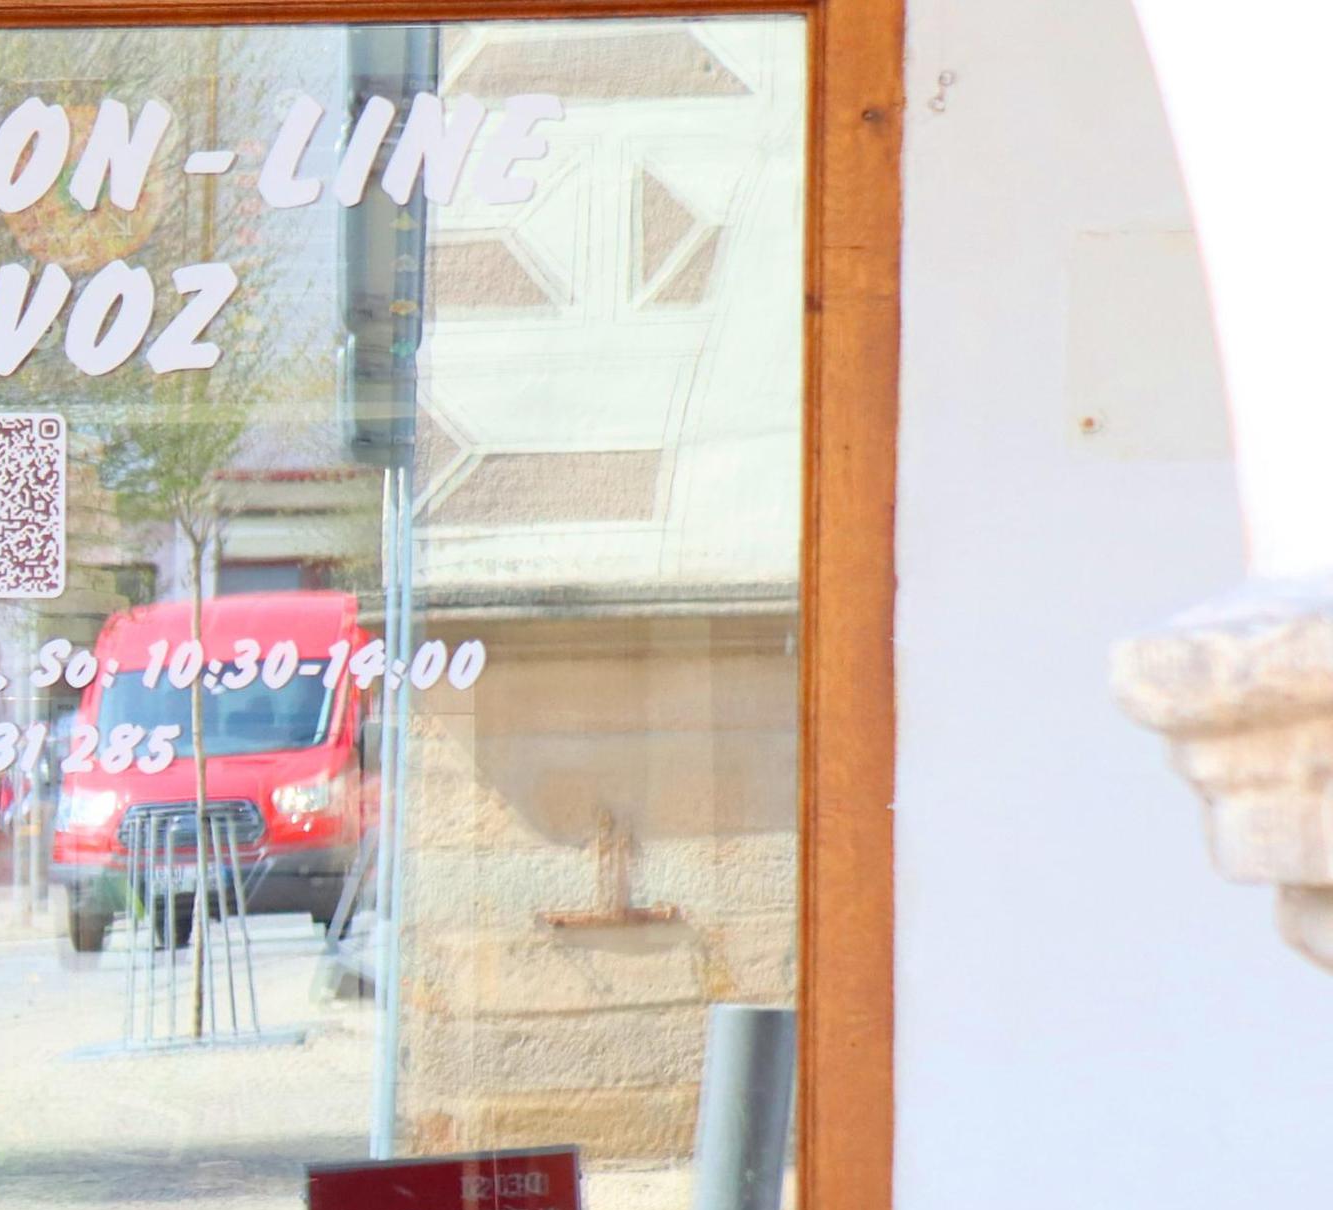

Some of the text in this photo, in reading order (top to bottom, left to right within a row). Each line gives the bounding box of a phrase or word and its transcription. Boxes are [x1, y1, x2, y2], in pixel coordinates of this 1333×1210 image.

[31, 639, 118, 690] So:
[142, 639, 487, 692] 10:30-14:00
[61, 724, 181, 774] 285
